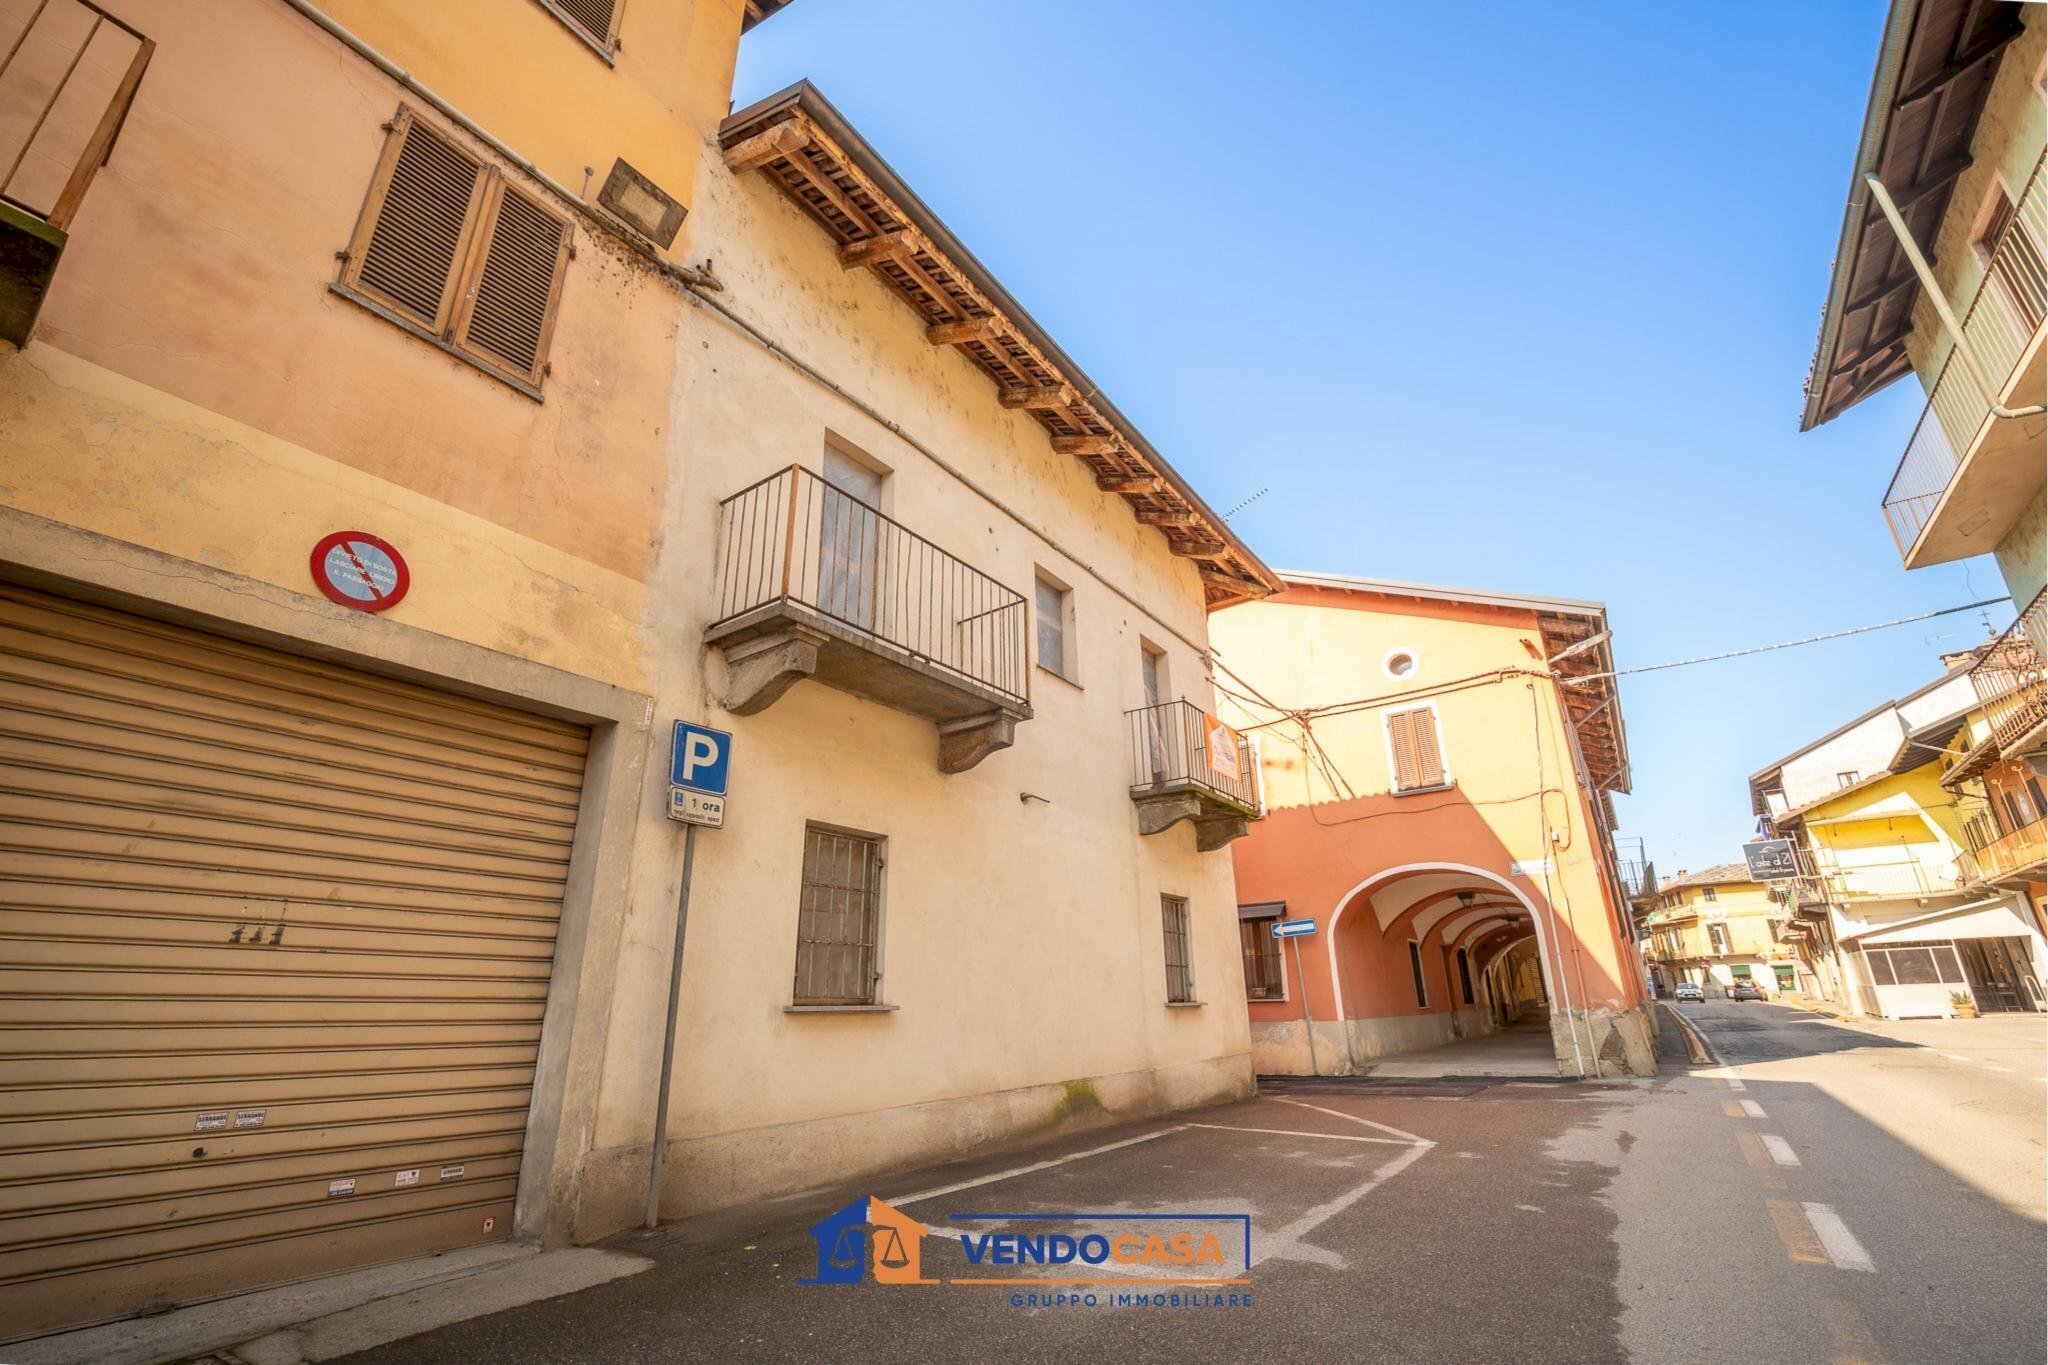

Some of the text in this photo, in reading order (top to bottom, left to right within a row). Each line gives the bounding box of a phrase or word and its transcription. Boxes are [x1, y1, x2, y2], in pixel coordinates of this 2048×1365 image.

[683, 731, 719, 780] P
[691, 798, 721, 813] 1 ora
